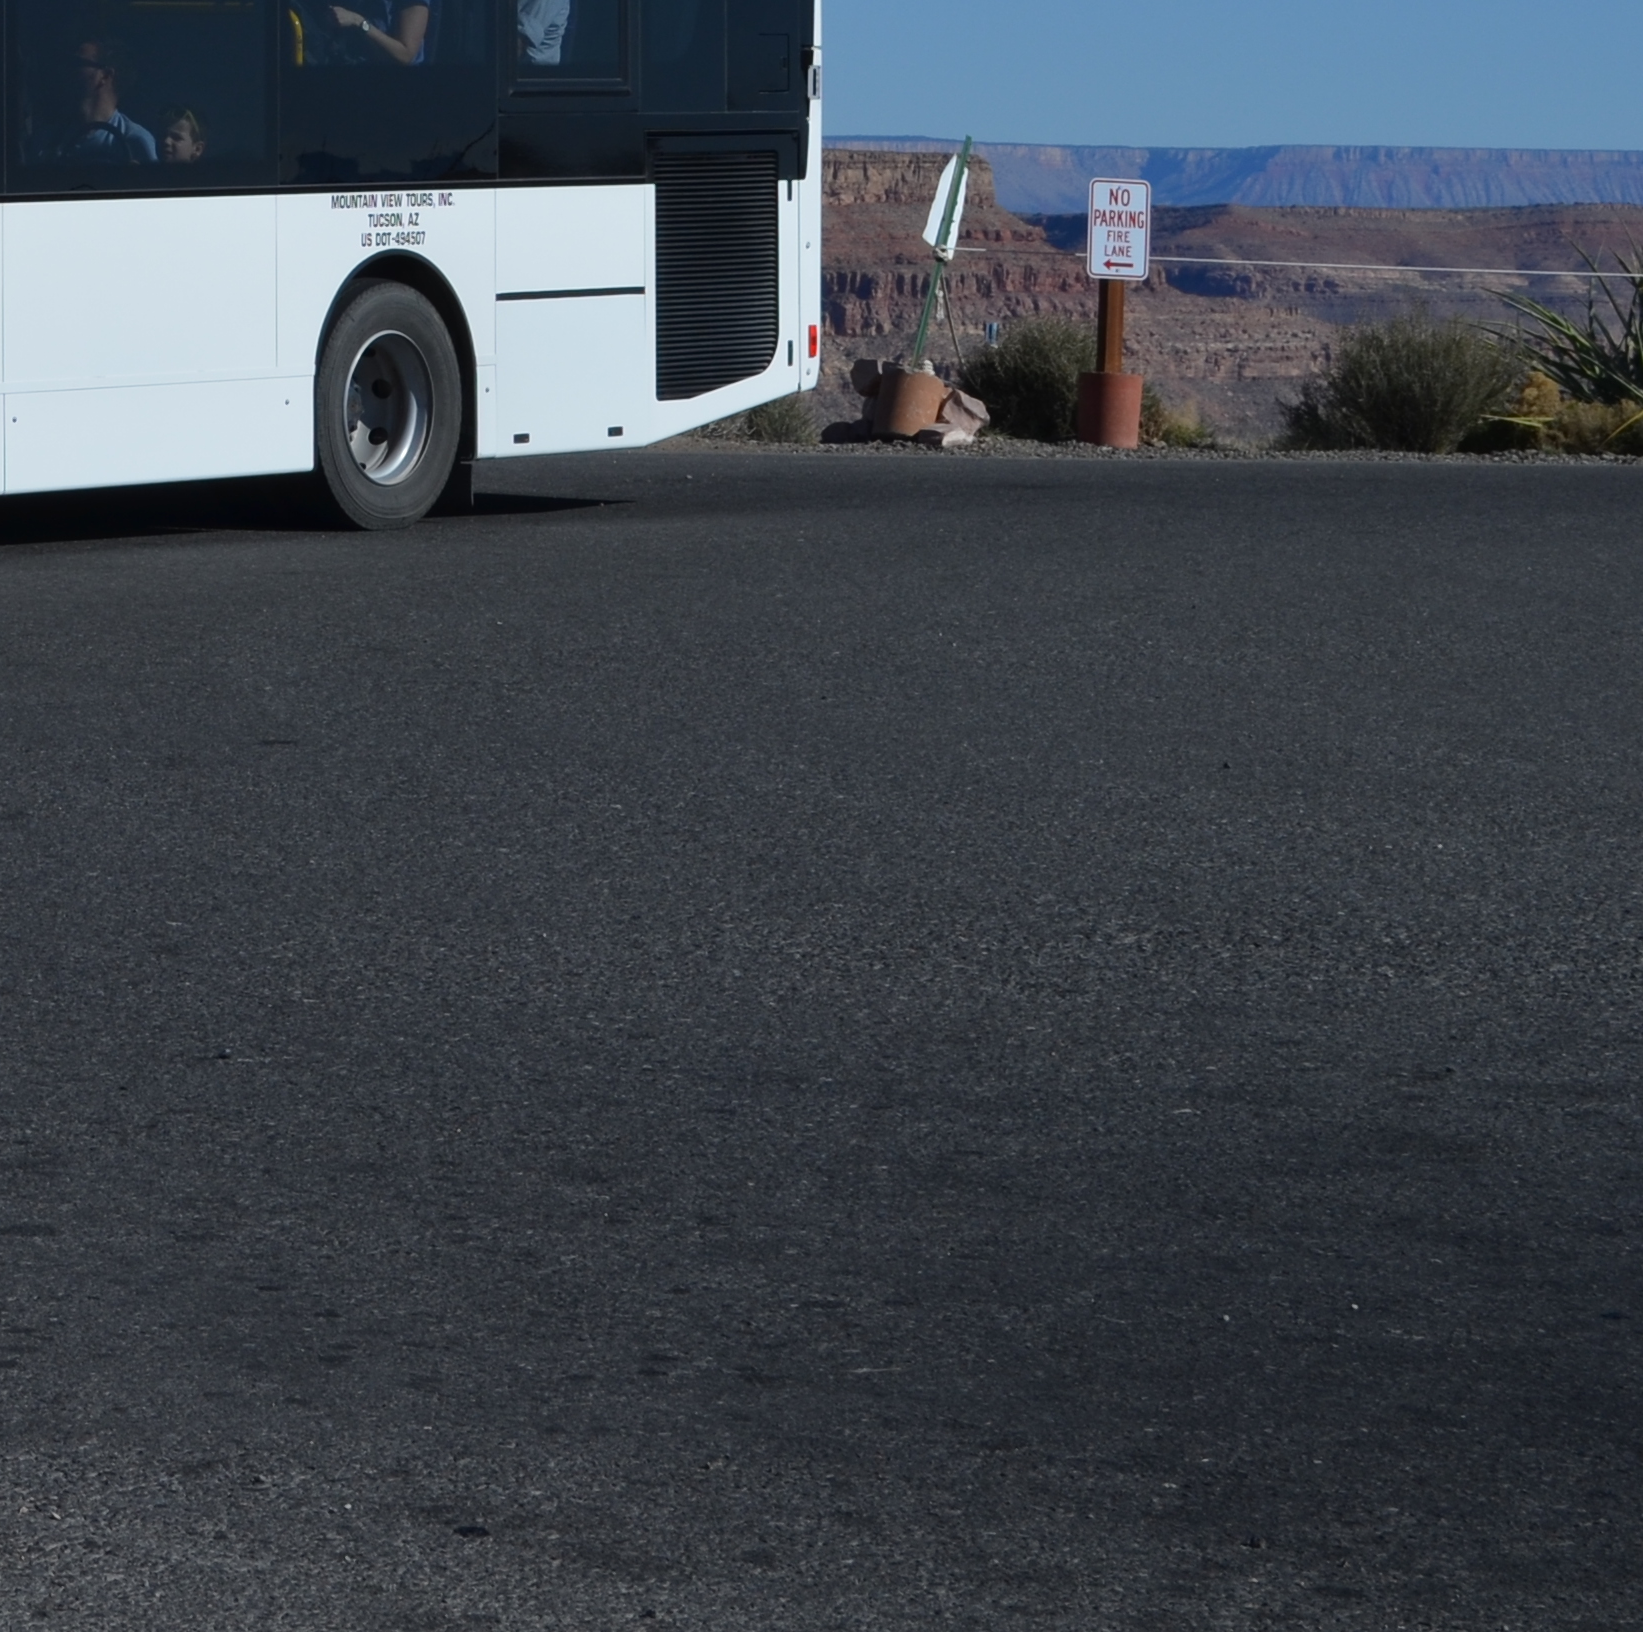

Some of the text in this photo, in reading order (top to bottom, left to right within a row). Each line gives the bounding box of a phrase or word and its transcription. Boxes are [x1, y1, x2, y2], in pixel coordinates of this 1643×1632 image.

[331, 192, 455, 210] MOUNTAIN VIEW TOURS, INC.
[1109, 188, 1131, 207] NO
[368, 212, 420, 228] TUCSON, AZ
[1093, 209, 1145, 229] PARKING
[361, 233, 373, 247] US
[1107, 230, 1131, 244] FIRE
[1104, 245, 1132, 258] LANE
